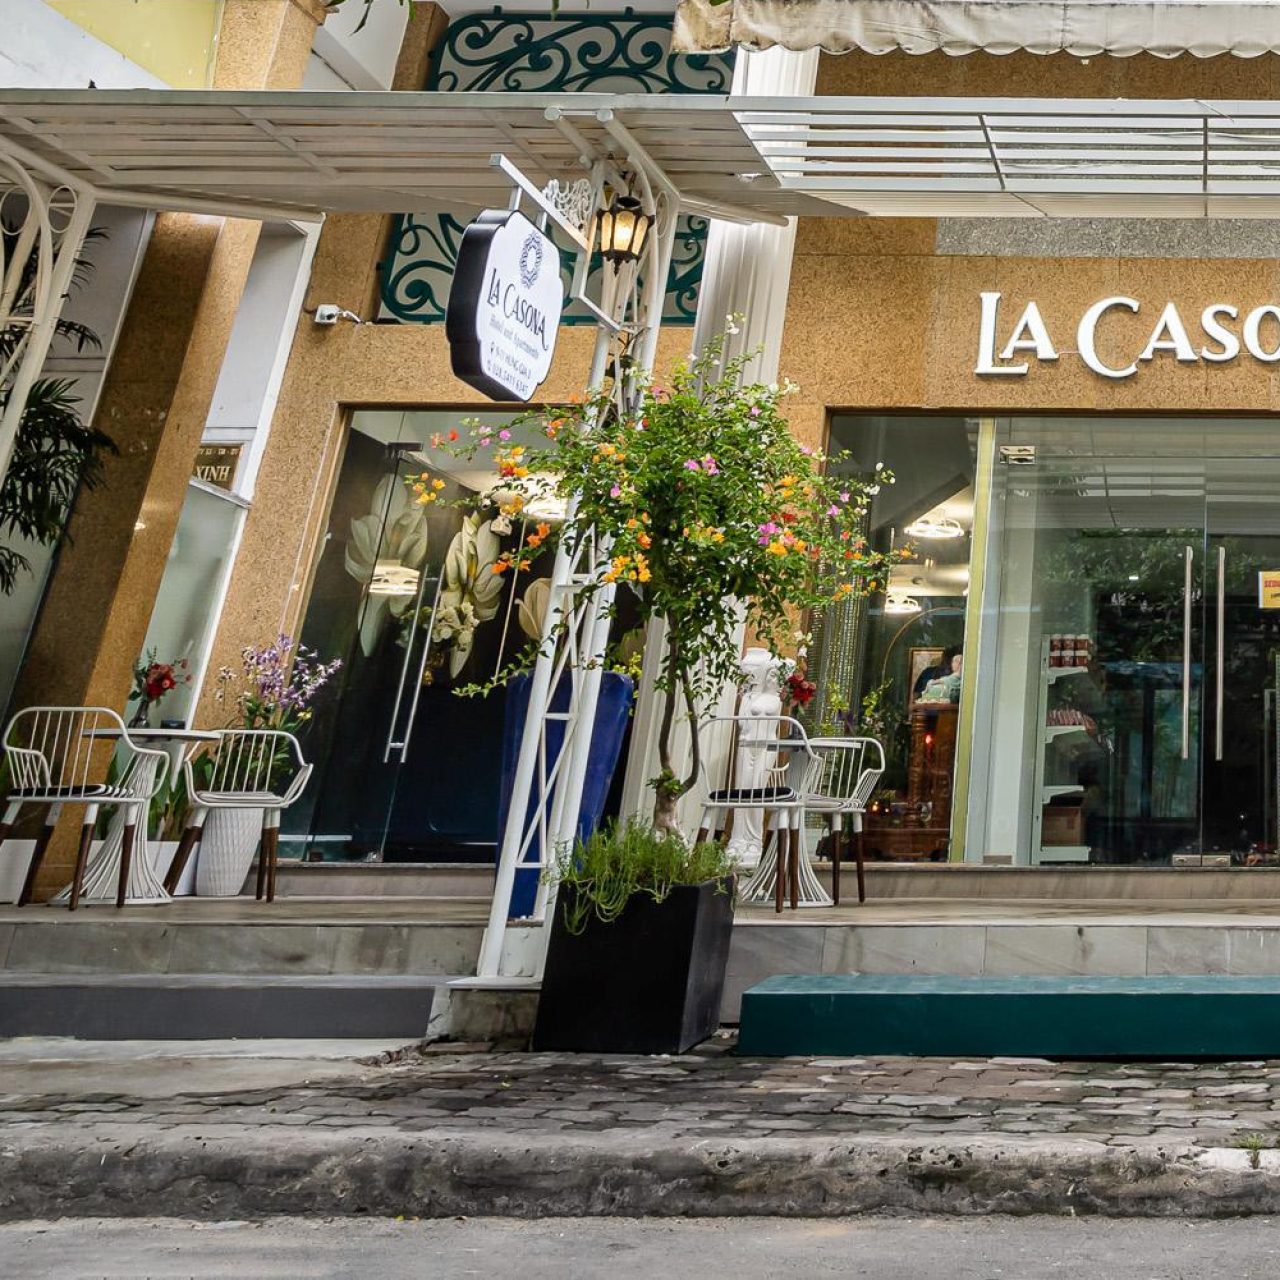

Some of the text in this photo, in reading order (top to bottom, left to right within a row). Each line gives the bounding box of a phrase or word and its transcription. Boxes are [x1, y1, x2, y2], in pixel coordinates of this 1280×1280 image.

[487, 267, 549, 352] LA CASONA
[974, 291, 1059, 375] LA
